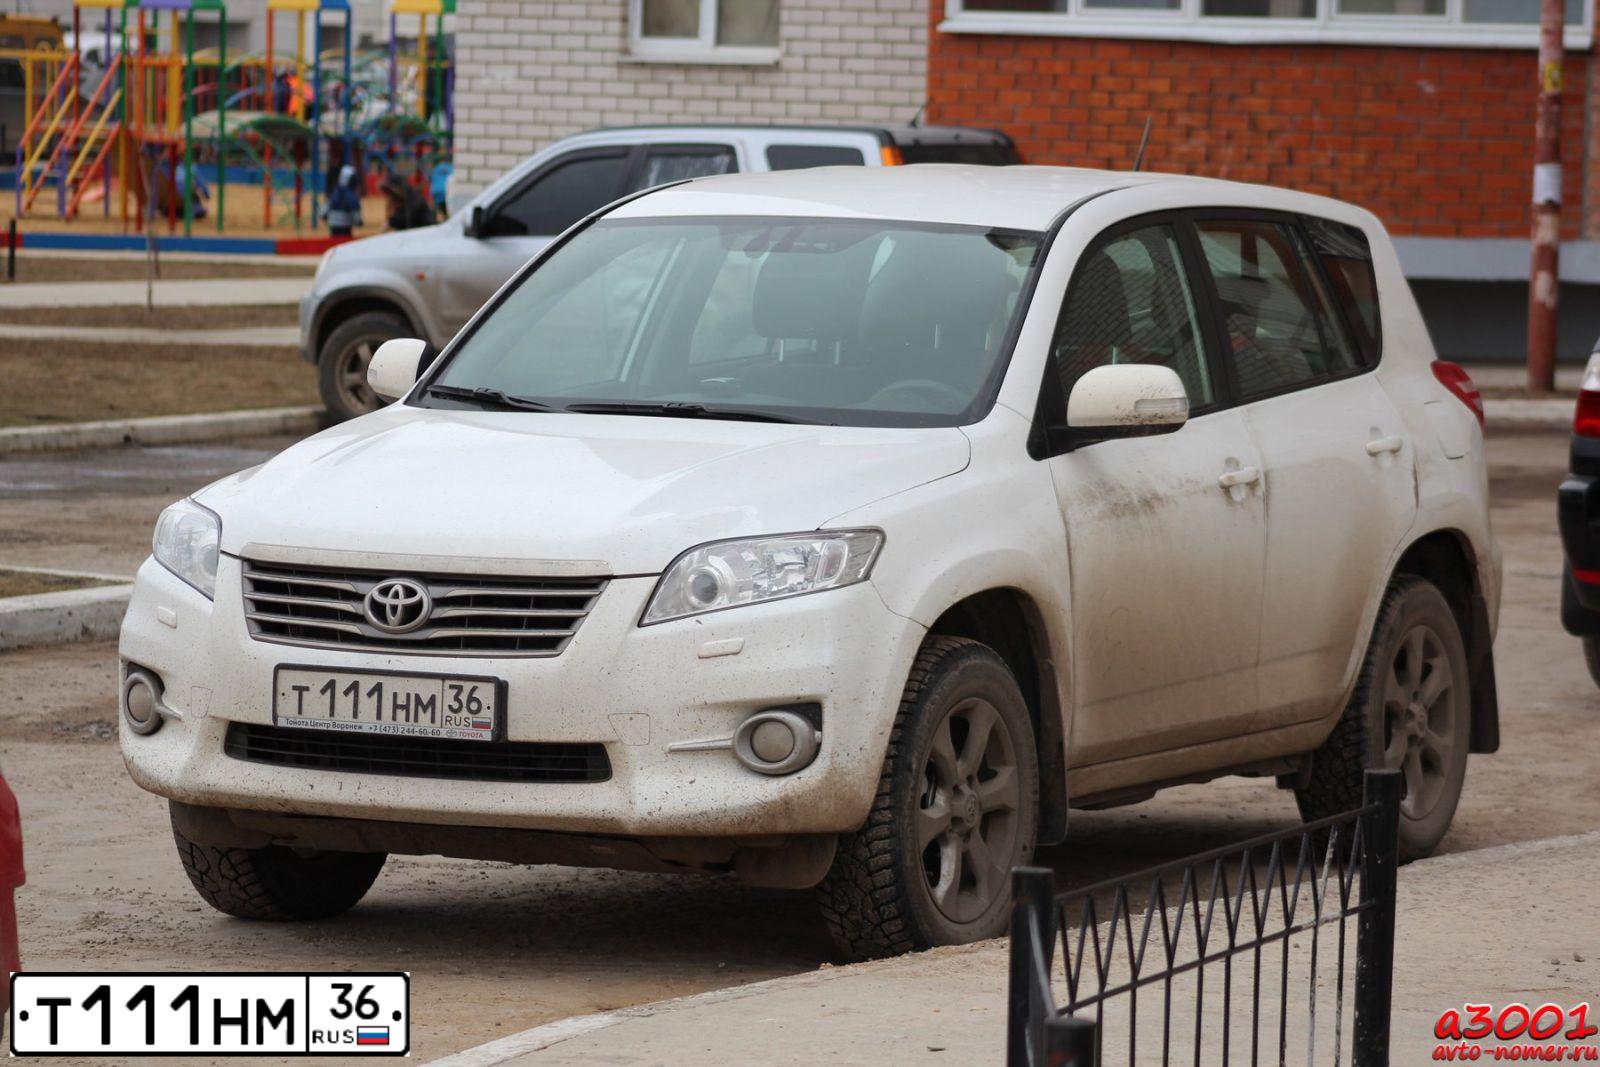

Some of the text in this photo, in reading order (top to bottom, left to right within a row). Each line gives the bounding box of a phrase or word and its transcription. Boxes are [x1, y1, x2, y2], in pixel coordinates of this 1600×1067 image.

[447, 684, 483, 715] 36
[309, 720, 331, 730] Центр
[333, 721, 363, 730] Воронеж
[444, 715, 471, 728] RUS
